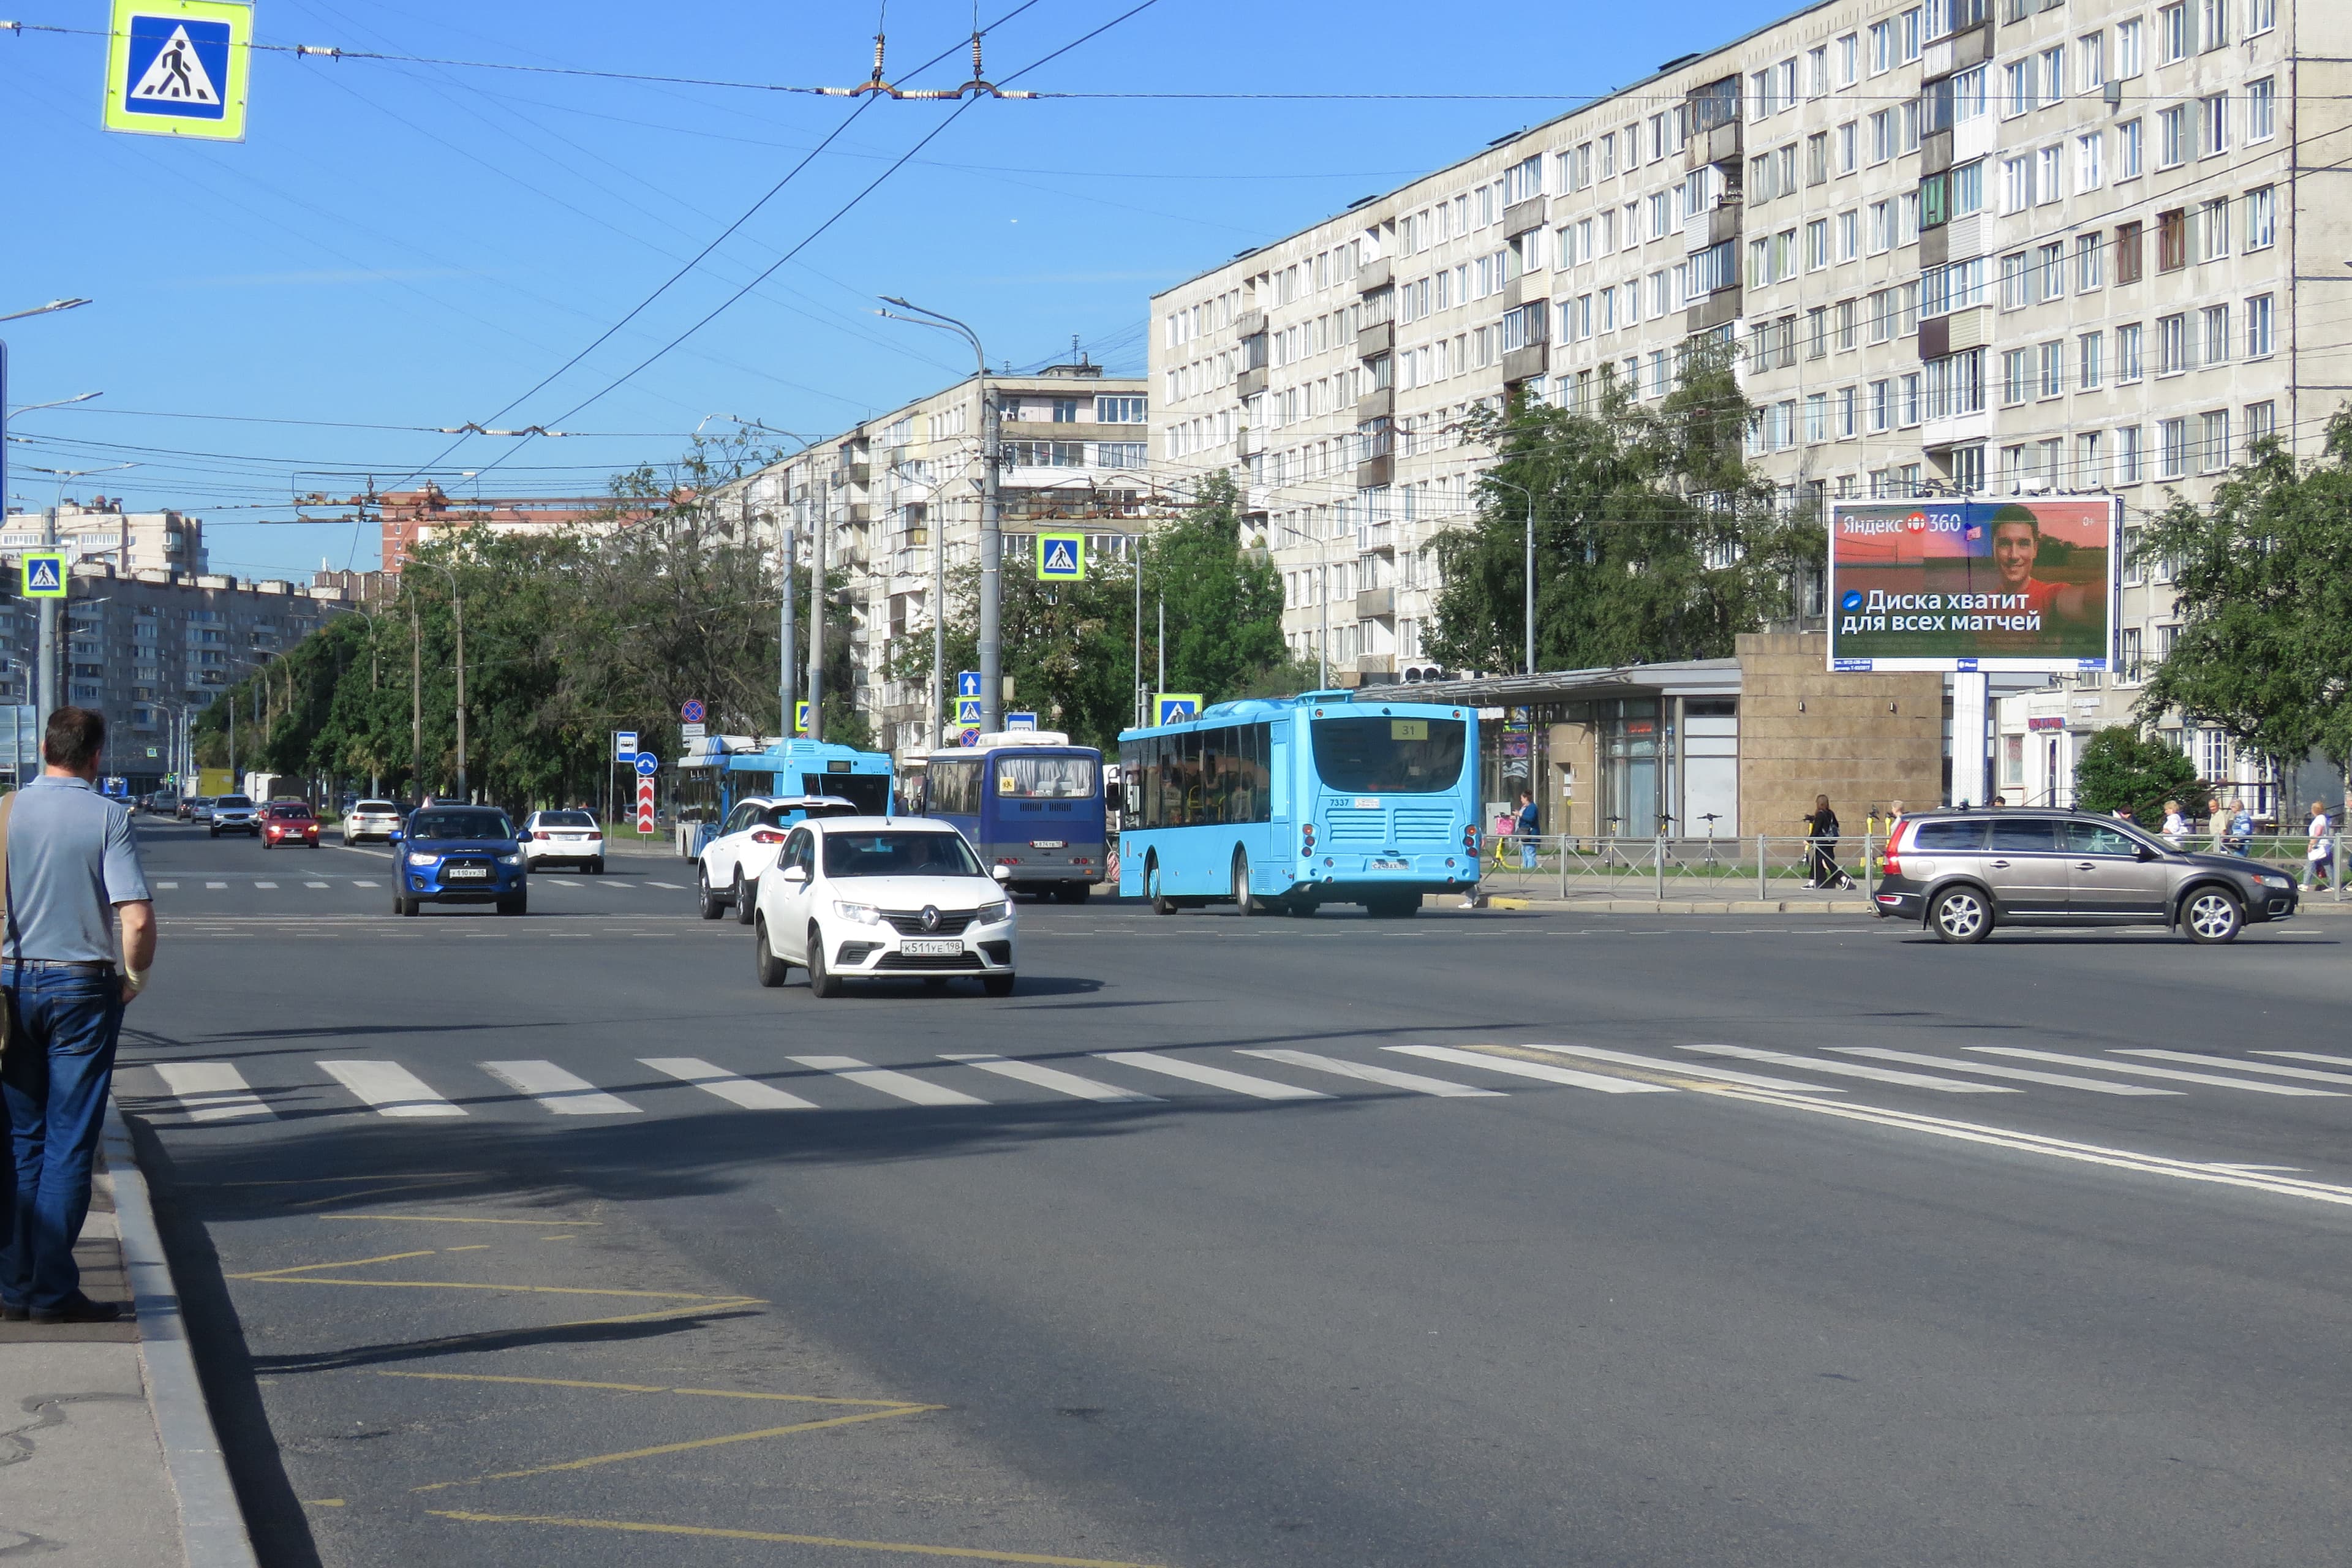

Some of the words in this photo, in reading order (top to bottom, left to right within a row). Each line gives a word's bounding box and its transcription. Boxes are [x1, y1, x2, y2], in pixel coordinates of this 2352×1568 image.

[1844, 515, 1903, 535] Яндекс
[1929, 514, 1961, 532] 360
[2083, 516, 2094, 527] 0+
[1866, 590, 1942, 614] Диска
[1947, 594, 2029, 609] хватит
[1841, 616, 1886, 635] для
[1892, 616, 1946, 631] всех
[1951, 610, 2040, 631] матчей
[1402, 725, 1414, 735] 31
